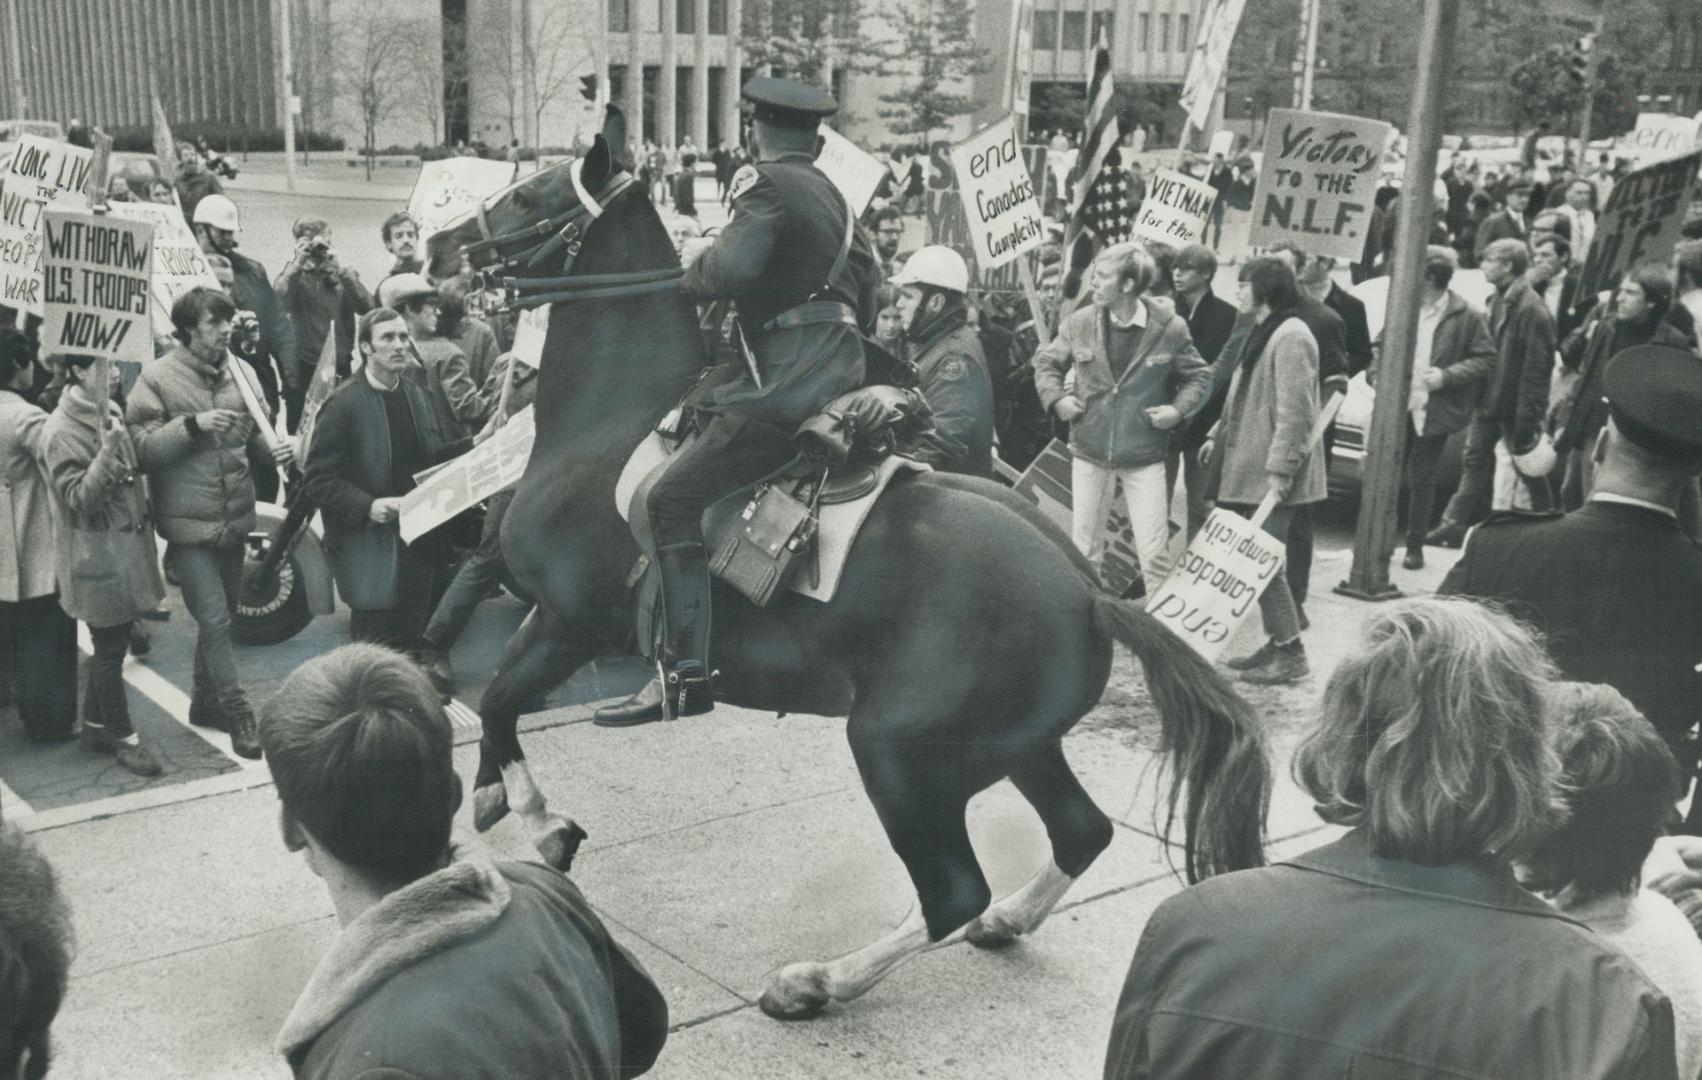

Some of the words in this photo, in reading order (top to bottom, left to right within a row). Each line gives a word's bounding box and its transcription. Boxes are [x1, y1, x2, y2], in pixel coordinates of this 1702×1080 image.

[12, 142, 51, 180] LONG
[55, 153, 93, 194] LIV
[970, 127, 1017, 178] end
[37, 185, 57, 200] THE
[976, 175, 1033, 223] Canada's
[1150, 174, 1213, 218] VIETNAM
[1275, 169, 1302, 188] TO
[1314, 174, 1356, 194] THE
[3, 192, 47, 230] VICT
[1141, 208, 1163, 228] for
[1166, 219, 1194, 241] the
[1262, 193, 1364, 237] N.L.F.
[45, 219, 149, 272] WITHDRAW
[987, 214, 1043, 258] Complicity
[4, 273, 39, 303] WAR
[44, 264, 77, 304] U.S.
[81, 268, 148, 315] TROOPS
[59, 311, 133, 352] NOW!
[1204, 514, 1279, 580] Complicity
[1151, 594, 1229, 643] end
